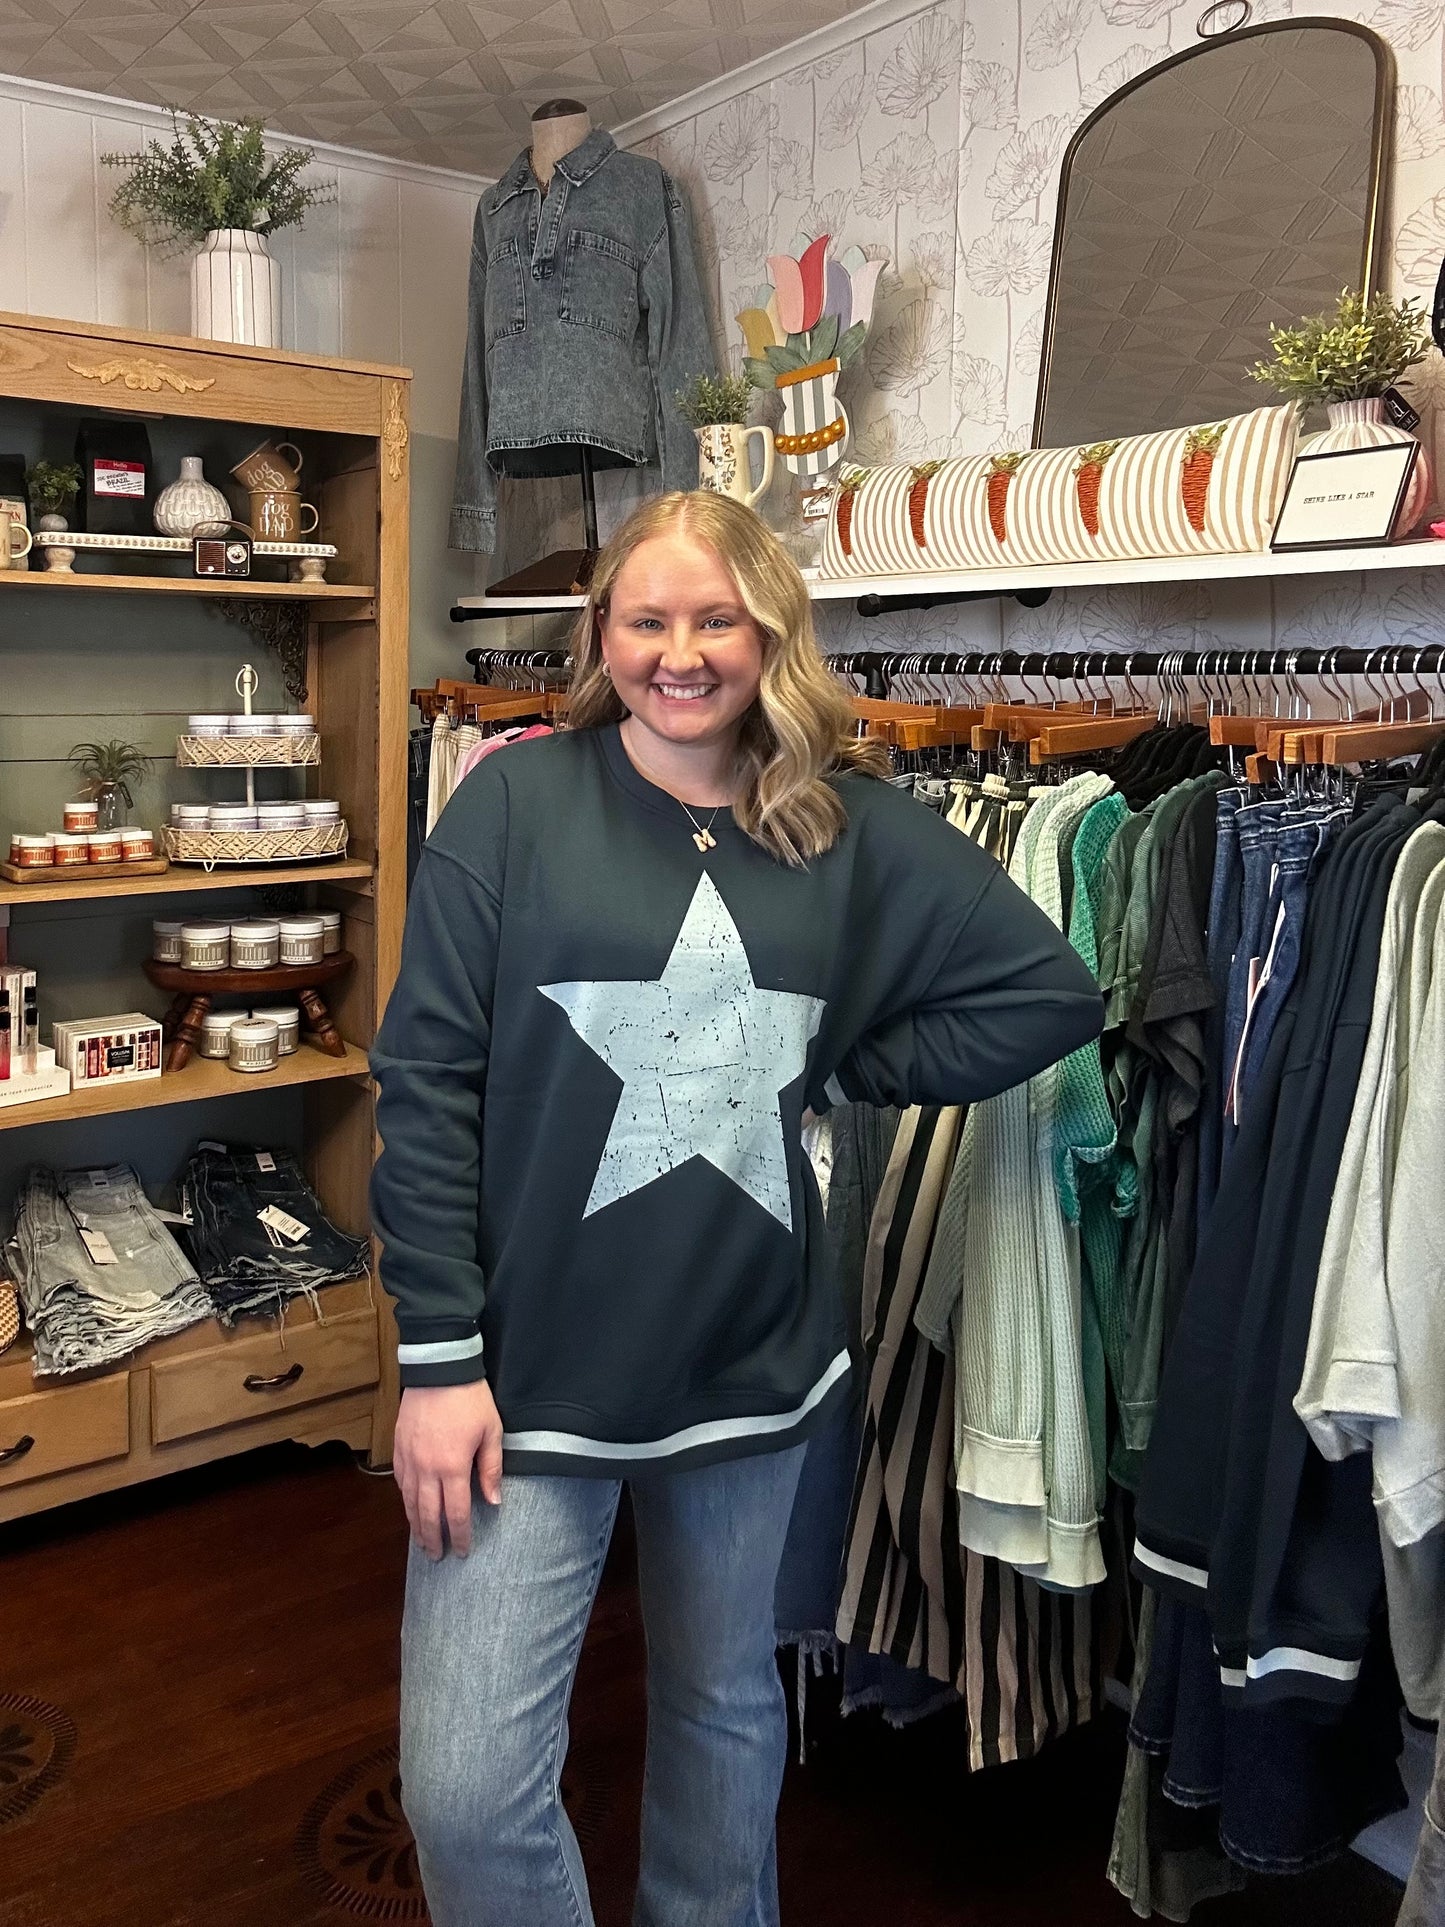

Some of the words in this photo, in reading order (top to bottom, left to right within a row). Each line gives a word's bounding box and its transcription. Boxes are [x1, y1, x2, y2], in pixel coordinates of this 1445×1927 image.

[247, 461, 275, 488] dog
[1303, 496, 1326, 504] SHINE
[1327, 494, 1346, 502] LIKE
[1356, 491, 1375, 499] STAR
[262, 502, 290, 519] dog
[259, 516, 294, 533] DAD
